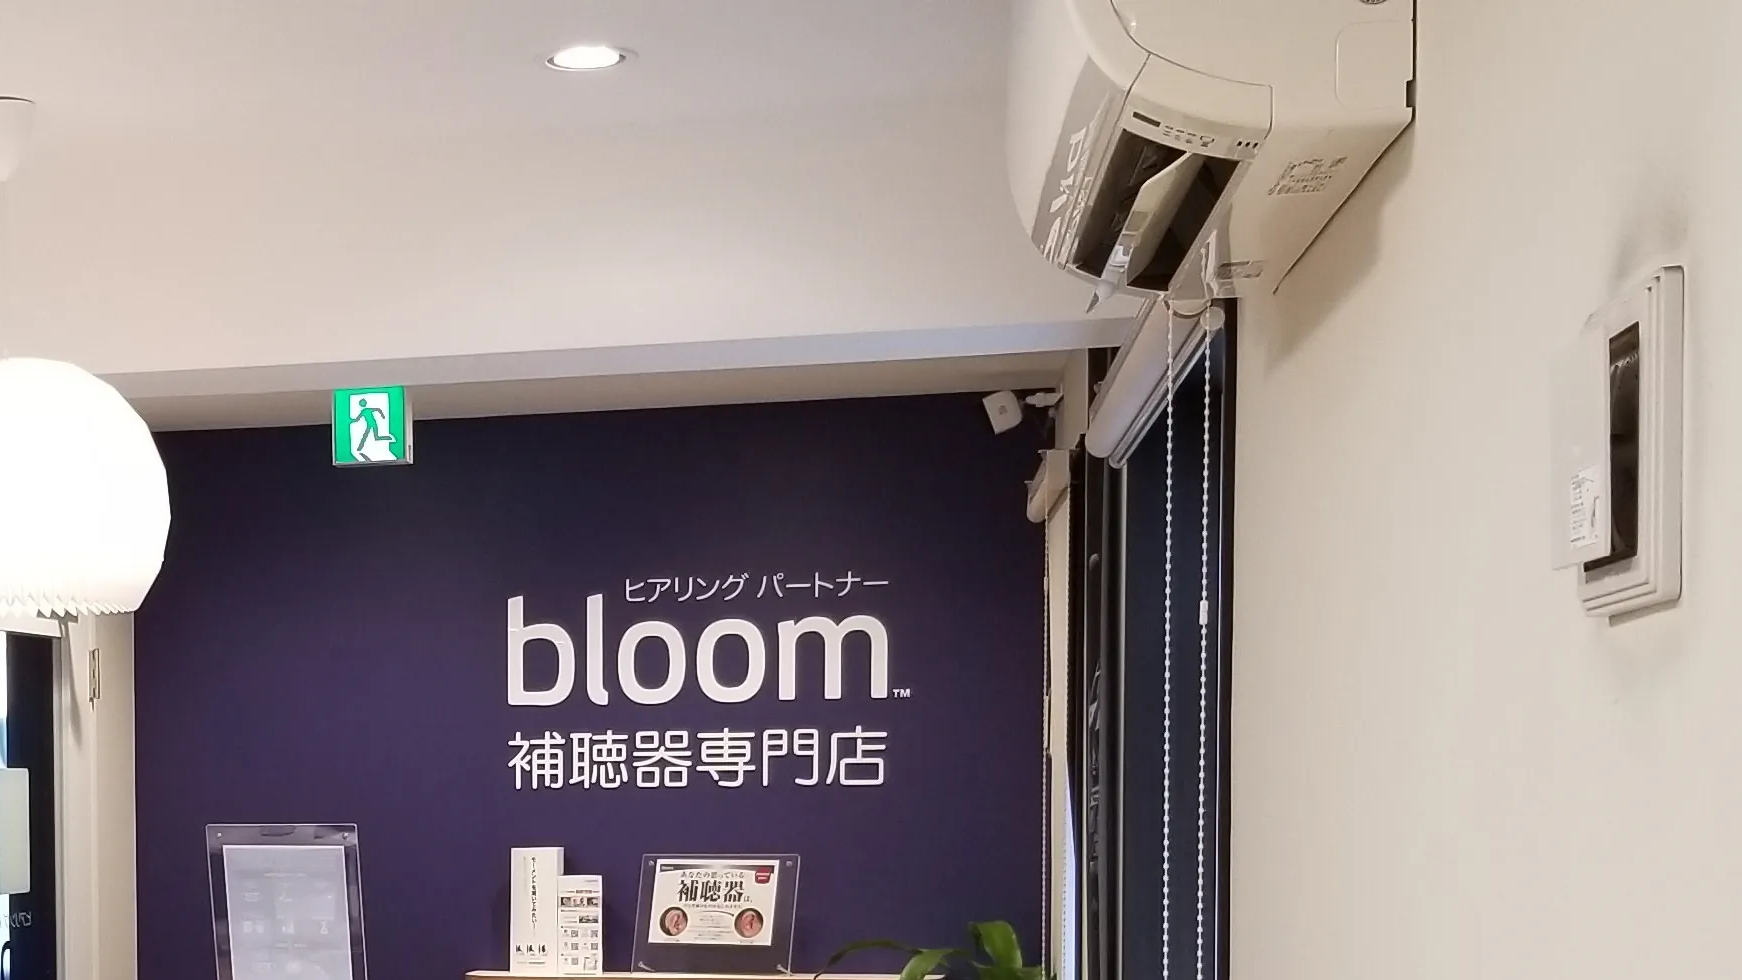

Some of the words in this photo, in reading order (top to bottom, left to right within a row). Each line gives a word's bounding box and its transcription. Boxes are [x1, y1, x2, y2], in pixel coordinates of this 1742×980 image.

[624, 573, 750, 603] ヒアリング
[756, 571, 889, 599] パートナー
[507, 593, 888, 706] bloom
[507, 725, 888, 789] 補聴器専門店
